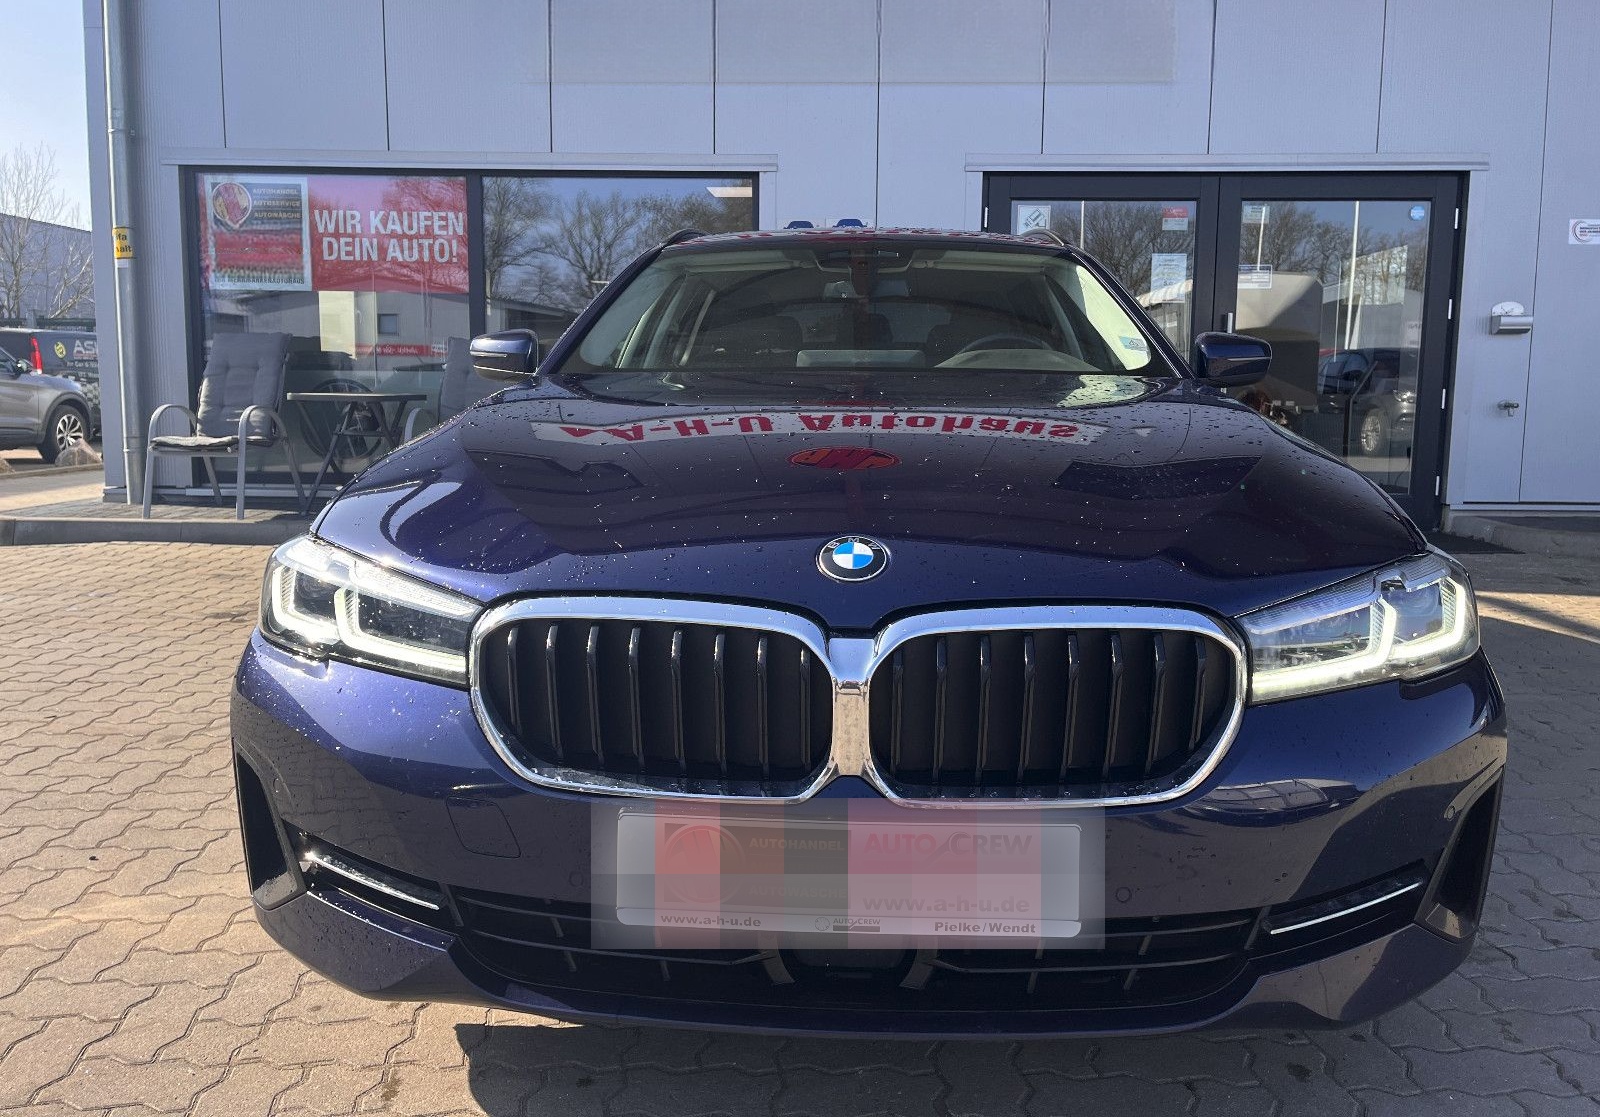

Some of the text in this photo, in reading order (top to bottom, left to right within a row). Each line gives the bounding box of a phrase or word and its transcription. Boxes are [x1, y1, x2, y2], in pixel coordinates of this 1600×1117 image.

[314, 209, 464, 237] WIR KAUFEN
[322, 237, 378, 262] DEIN
[386, 238, 458, 264] AUTO!
[827, 537, 881, 550] BMW
[749, 838, 845, 852] AUTOHANDEL
[862, 895, 1031, 914] www.a-h-u.de
[660, 914, 762, 928] www.a-h-u.de
[934, 921, 1037, 935] Pielke/Wendt
